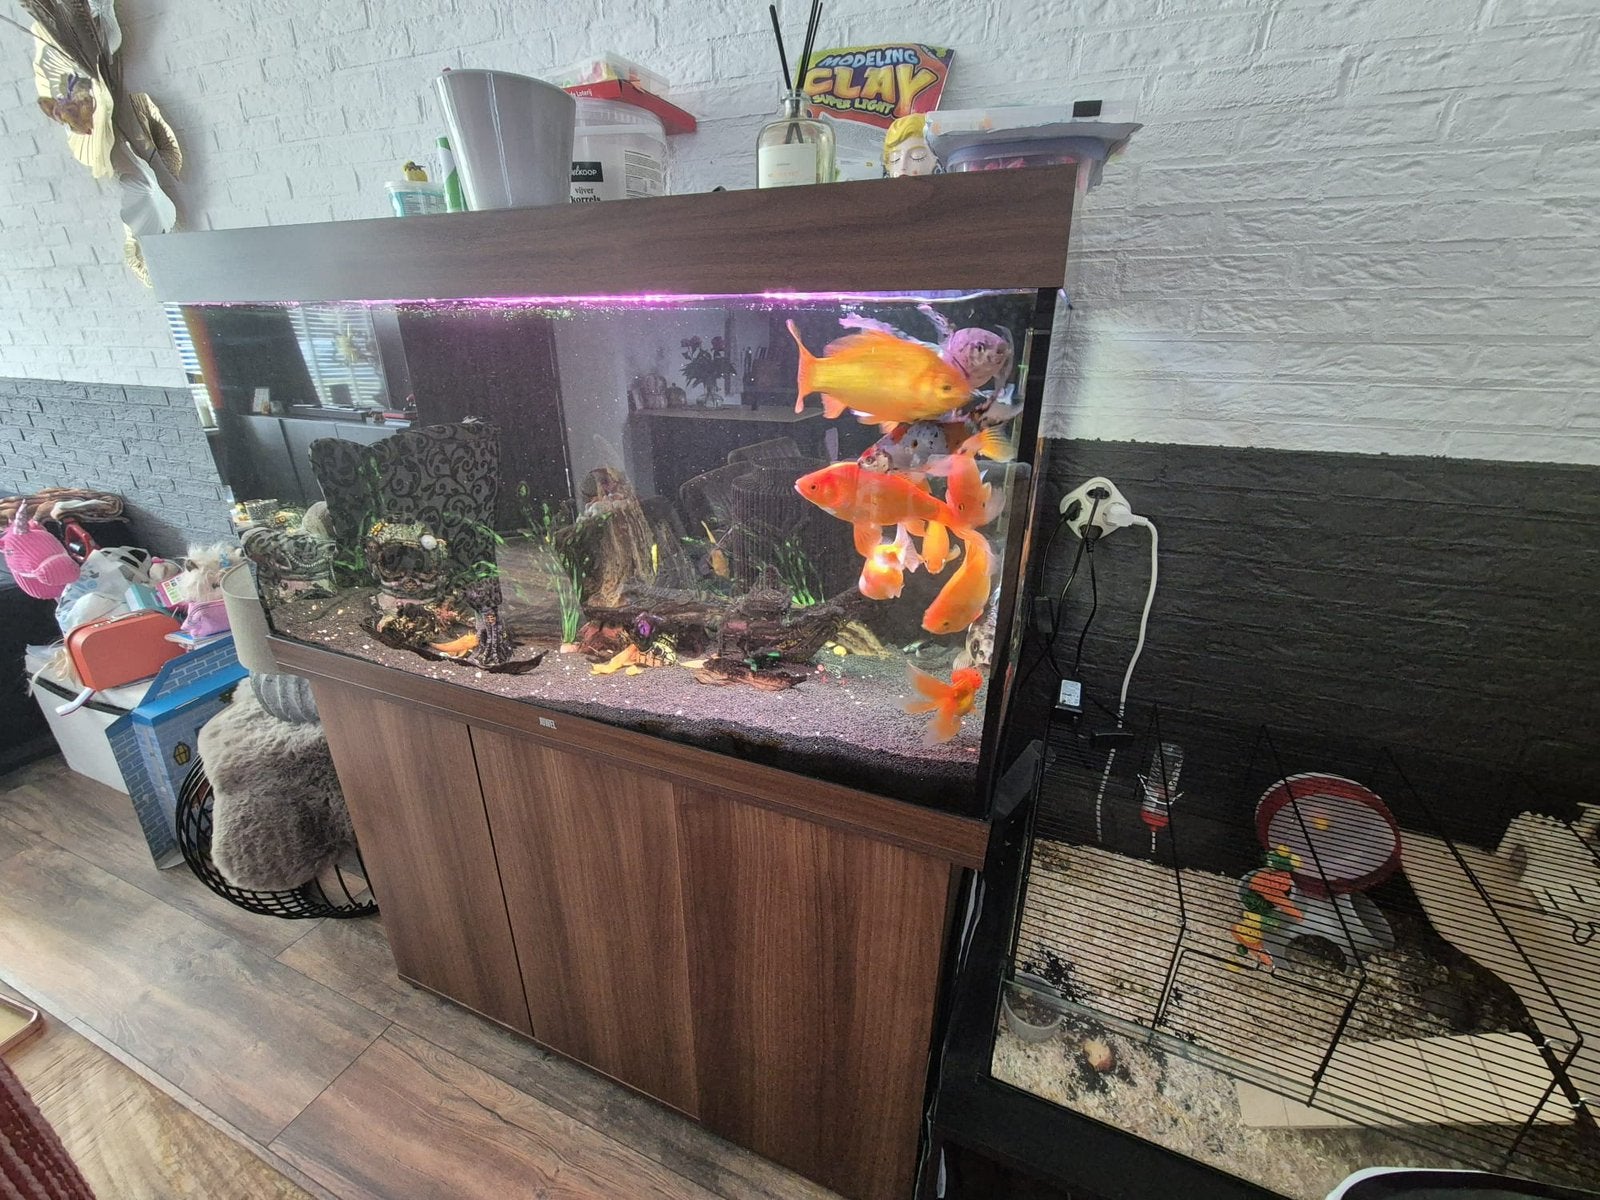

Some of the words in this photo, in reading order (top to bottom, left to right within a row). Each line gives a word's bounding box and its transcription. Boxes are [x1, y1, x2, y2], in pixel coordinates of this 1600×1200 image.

[818, 48, 919, 68] MODELING
[803, 63, 938, 117] CLAY
[811, 95, 851, 110] SUPER
[853, 98, 895, 115] LIGHT
